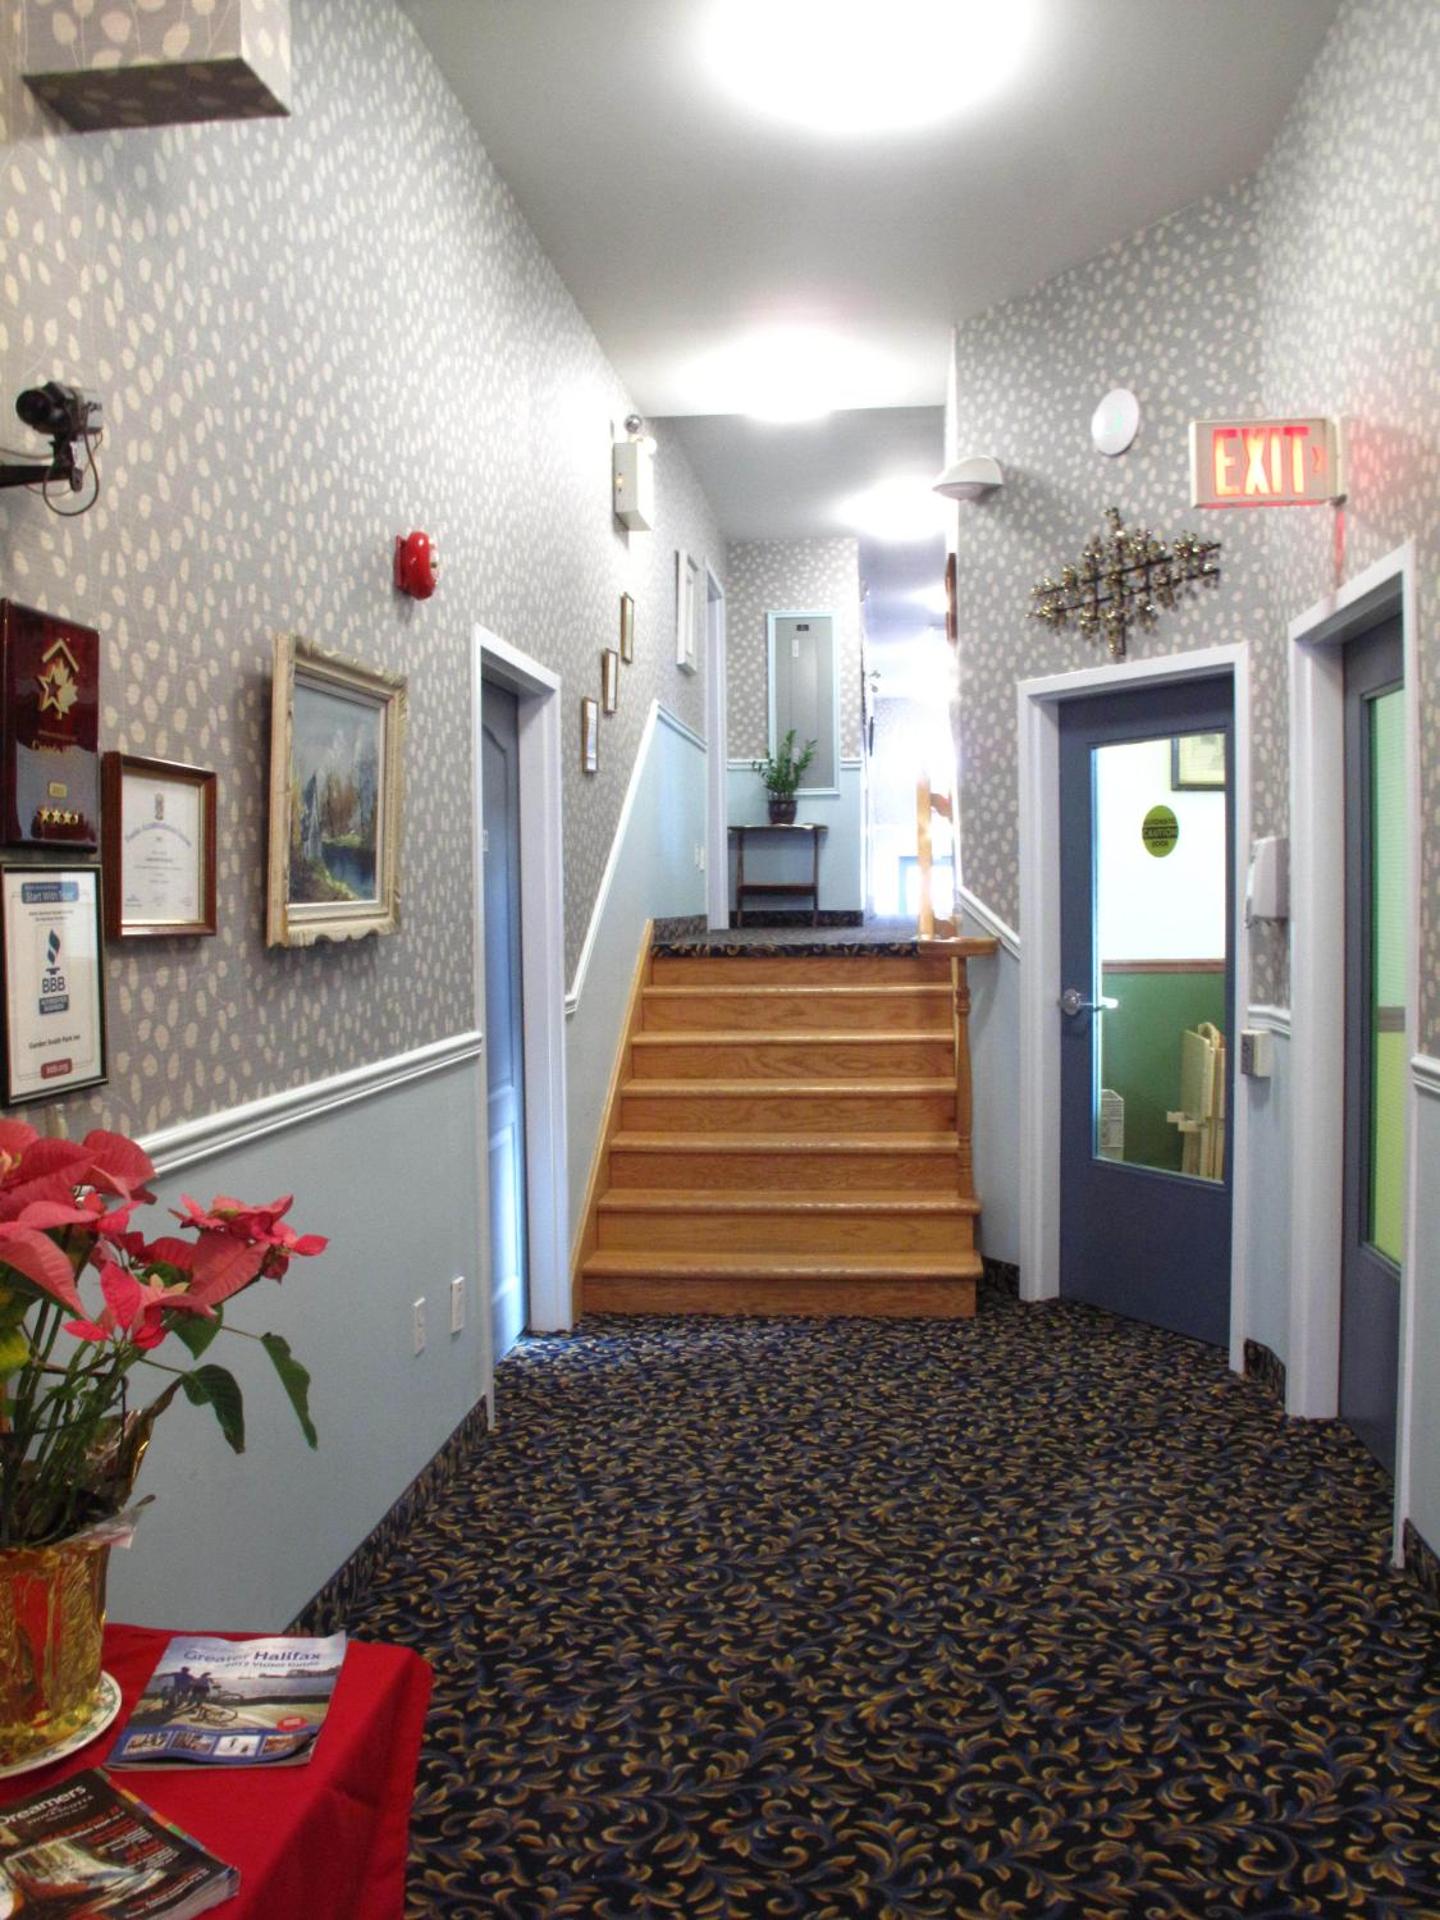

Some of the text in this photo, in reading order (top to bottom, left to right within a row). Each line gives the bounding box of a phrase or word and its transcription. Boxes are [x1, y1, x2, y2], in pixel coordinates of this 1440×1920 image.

[1213, 426, 1309, 496] EXIT
[42, 976, 66, 995] BBB
[183, 1650, 320, 1662] Greater Halifax
